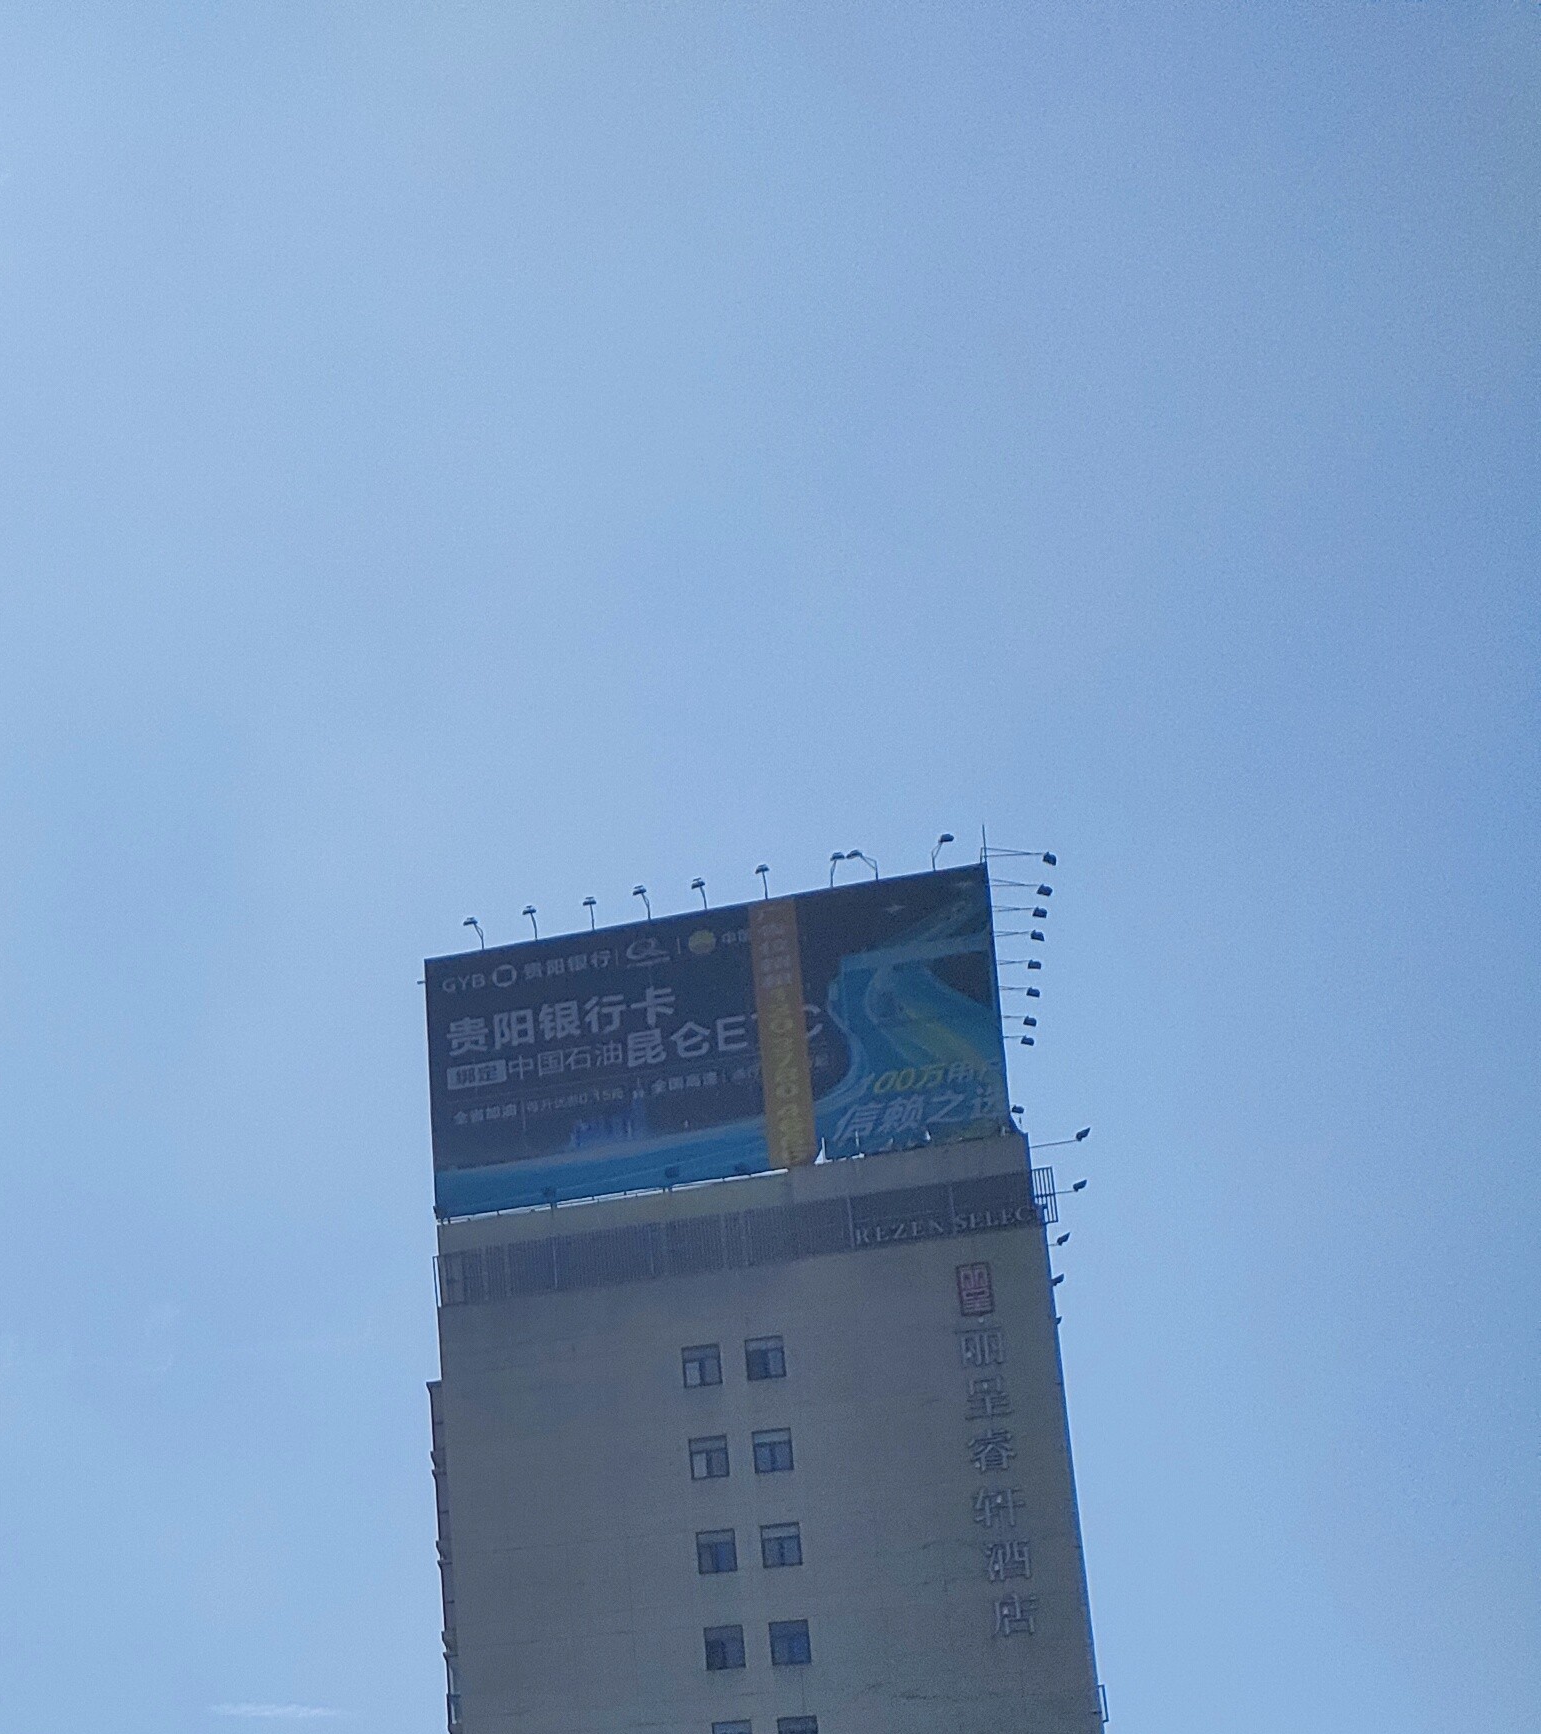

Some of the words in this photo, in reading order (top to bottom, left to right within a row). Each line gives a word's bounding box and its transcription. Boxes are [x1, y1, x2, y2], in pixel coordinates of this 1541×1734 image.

[522, 950, 611, 980] 贵阳银行
[442, 973, 486, 993] GYB
[446, 985, 676, 1057] 贵阳银行卡
[952, 1206, 1039, 1229] SELEC
